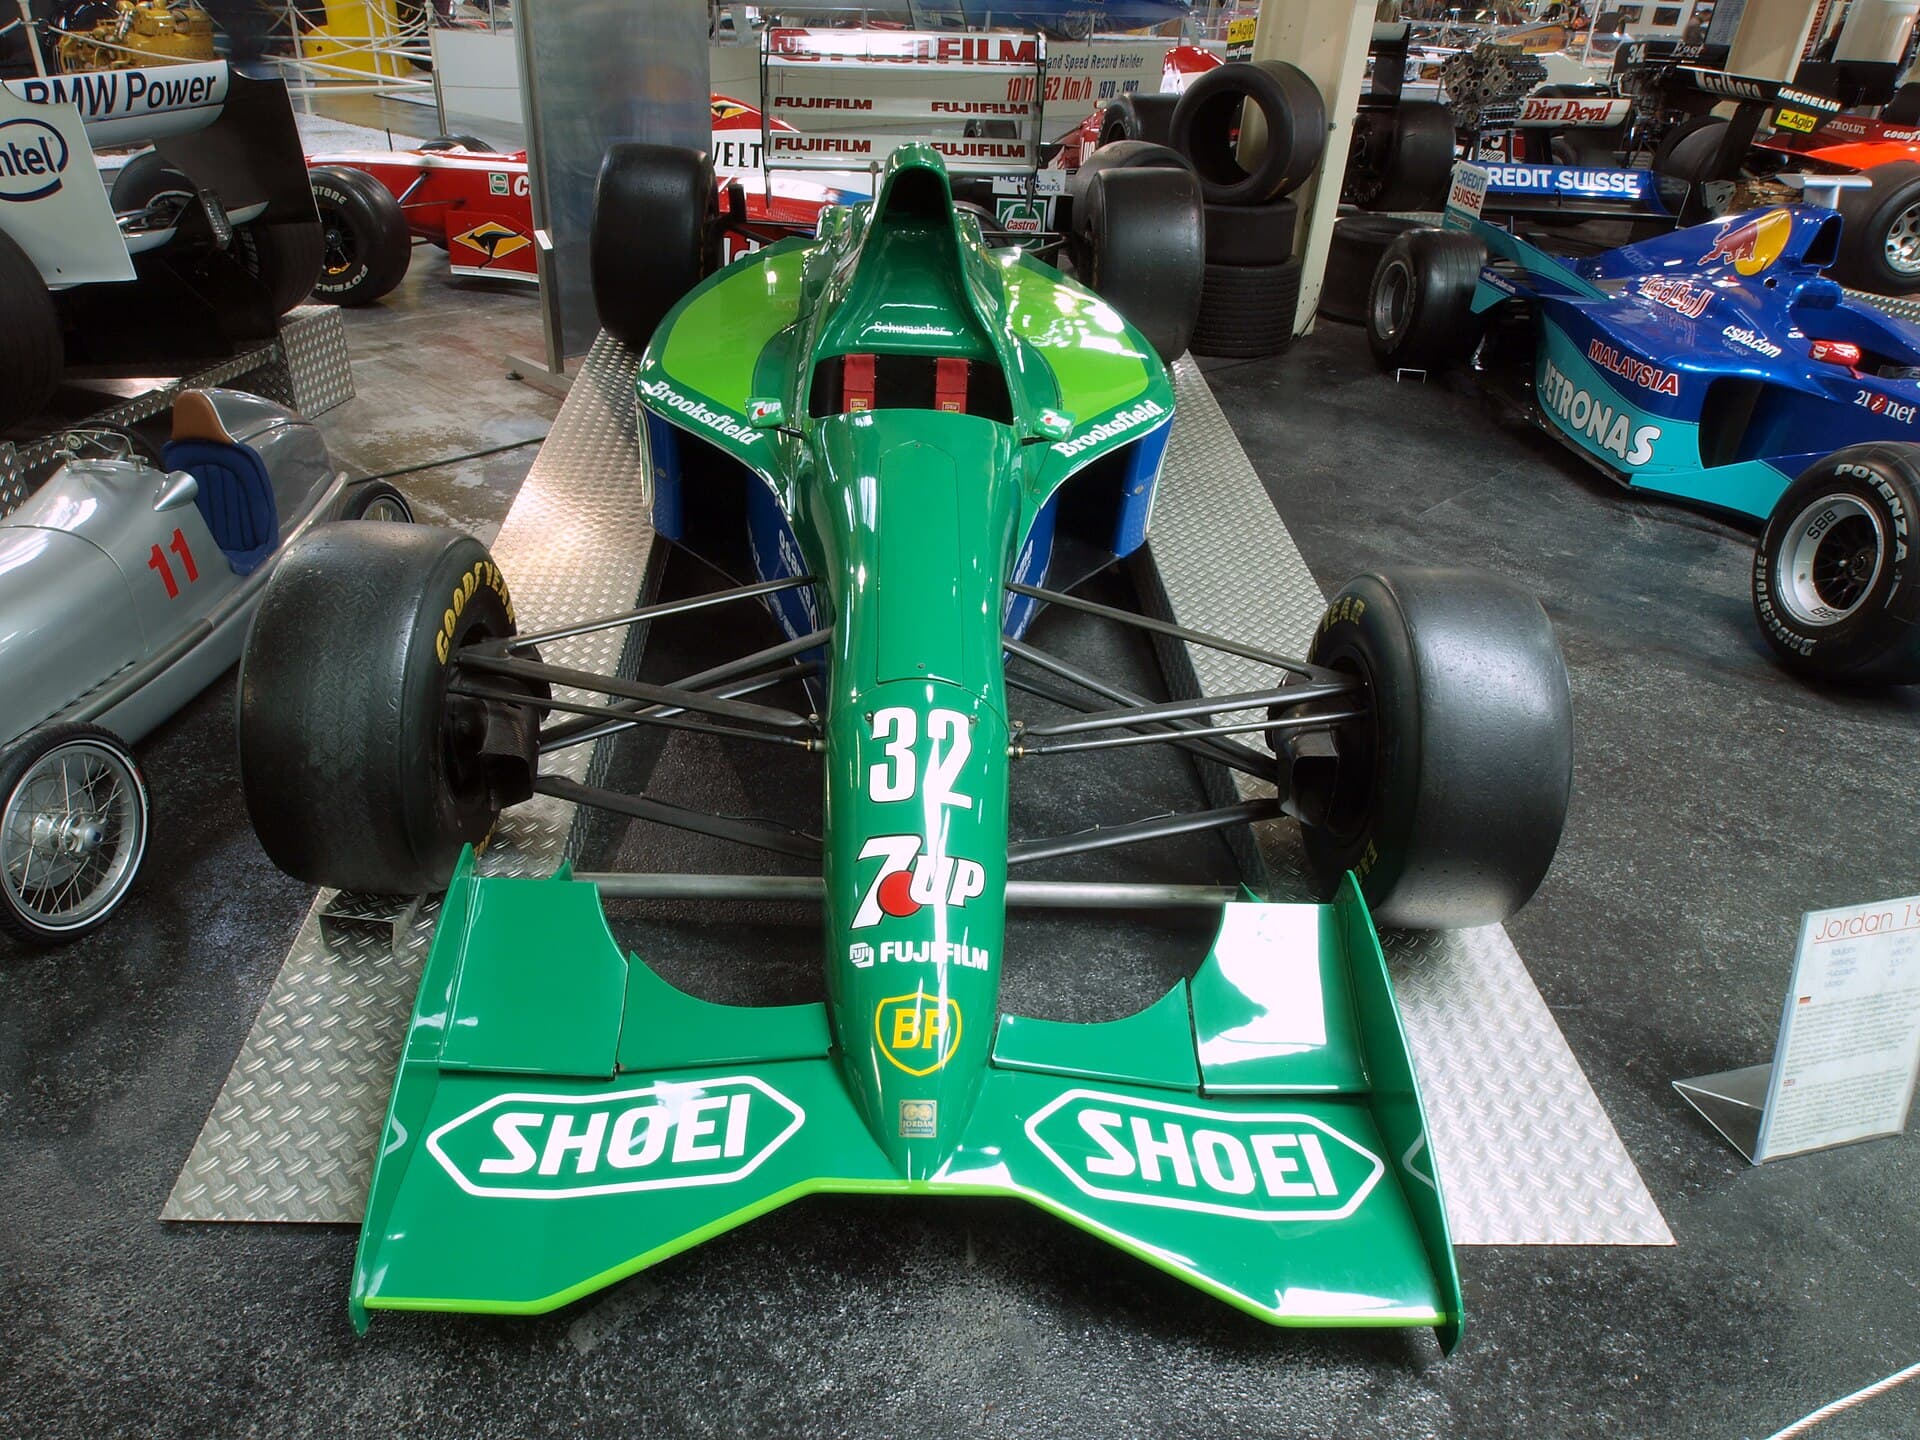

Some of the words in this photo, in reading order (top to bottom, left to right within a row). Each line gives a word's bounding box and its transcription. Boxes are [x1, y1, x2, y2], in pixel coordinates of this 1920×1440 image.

[1047, 54, 1063, 69] and
[1064, 54, 1090, 72] Speed
[1091, 54, 1118, 69] Record
[1119, 55, 1143, 69] Holder
[125, 72, 217, 112] Power
[774, 96, 873, 110] FUJIFILM
[1062, 77, 1092, 102] Km/h
[1098, 80, 1116, 98] 1970
[1777, 87, 1842, 112] MICHELIN
[931, 102, 1028, 115] FUJIFILM
[1522, 99, 1562, 121] Dirt
[1561, 101, 1613, 121] Devil
[1790, 114, 1815, 130] Agip
[0, 136, 56, 177] ntel
[775, 137, 871, 153] FUJIFILM
[931, 142, 1026, 158] FUJIFILM
[1485, 166, 1552, 188] REDIT
[1554, 170, 1641, 194] SUISSE
[1452, 185, 1481, 209] SUISSE
[1006, 219, 1039, 231] Castrol
[874, 321, 947, 336] Schumacher
[1722, 324, 1782, 359] cspb.com
[1587, 338, 1680, 397] MALAYSIA
[648, 379, 764, 446] Brooksfield
[1543, 359, 1662, 468] PETRONAS
[1050, 399, 1164, 458] Brooksfield
[1834, 463, 1909, 563] POTENZA
[147, 527, 200, 600] 11
[868, 706, 973, 810] 32
[1815, 911, 1894, 941] Jordan
[880, 940, 989, 972] FUJIFILM
[891, 1008, 951, 1050] BP
[478, 1093, 752, 1176] SHOEI
[1077, 1107, 1339, 1198] SHOEI
